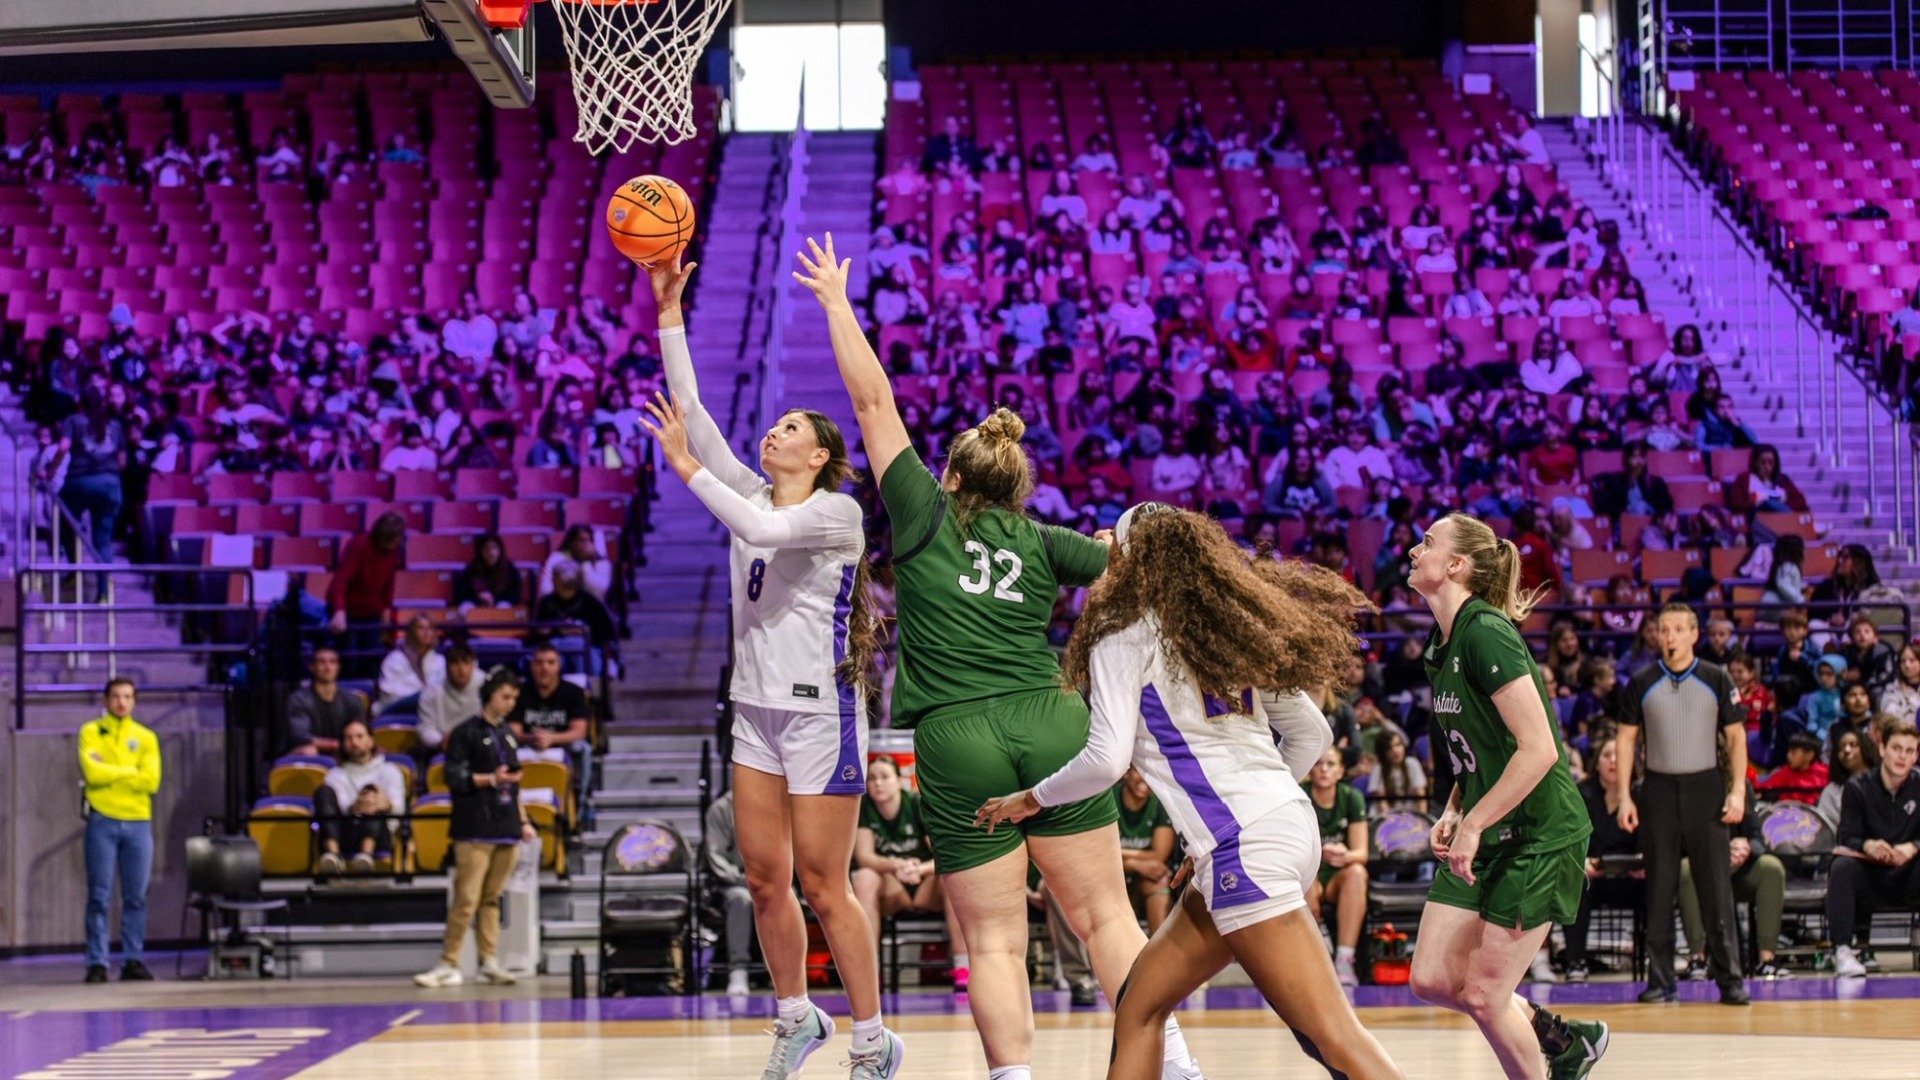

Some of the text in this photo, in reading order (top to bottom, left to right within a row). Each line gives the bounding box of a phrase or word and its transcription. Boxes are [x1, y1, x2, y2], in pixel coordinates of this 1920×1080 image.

[626, 181, 664, 207] Wil
[747, 558, 766, 602] 8
[958, 540, 1024, 604] 32
